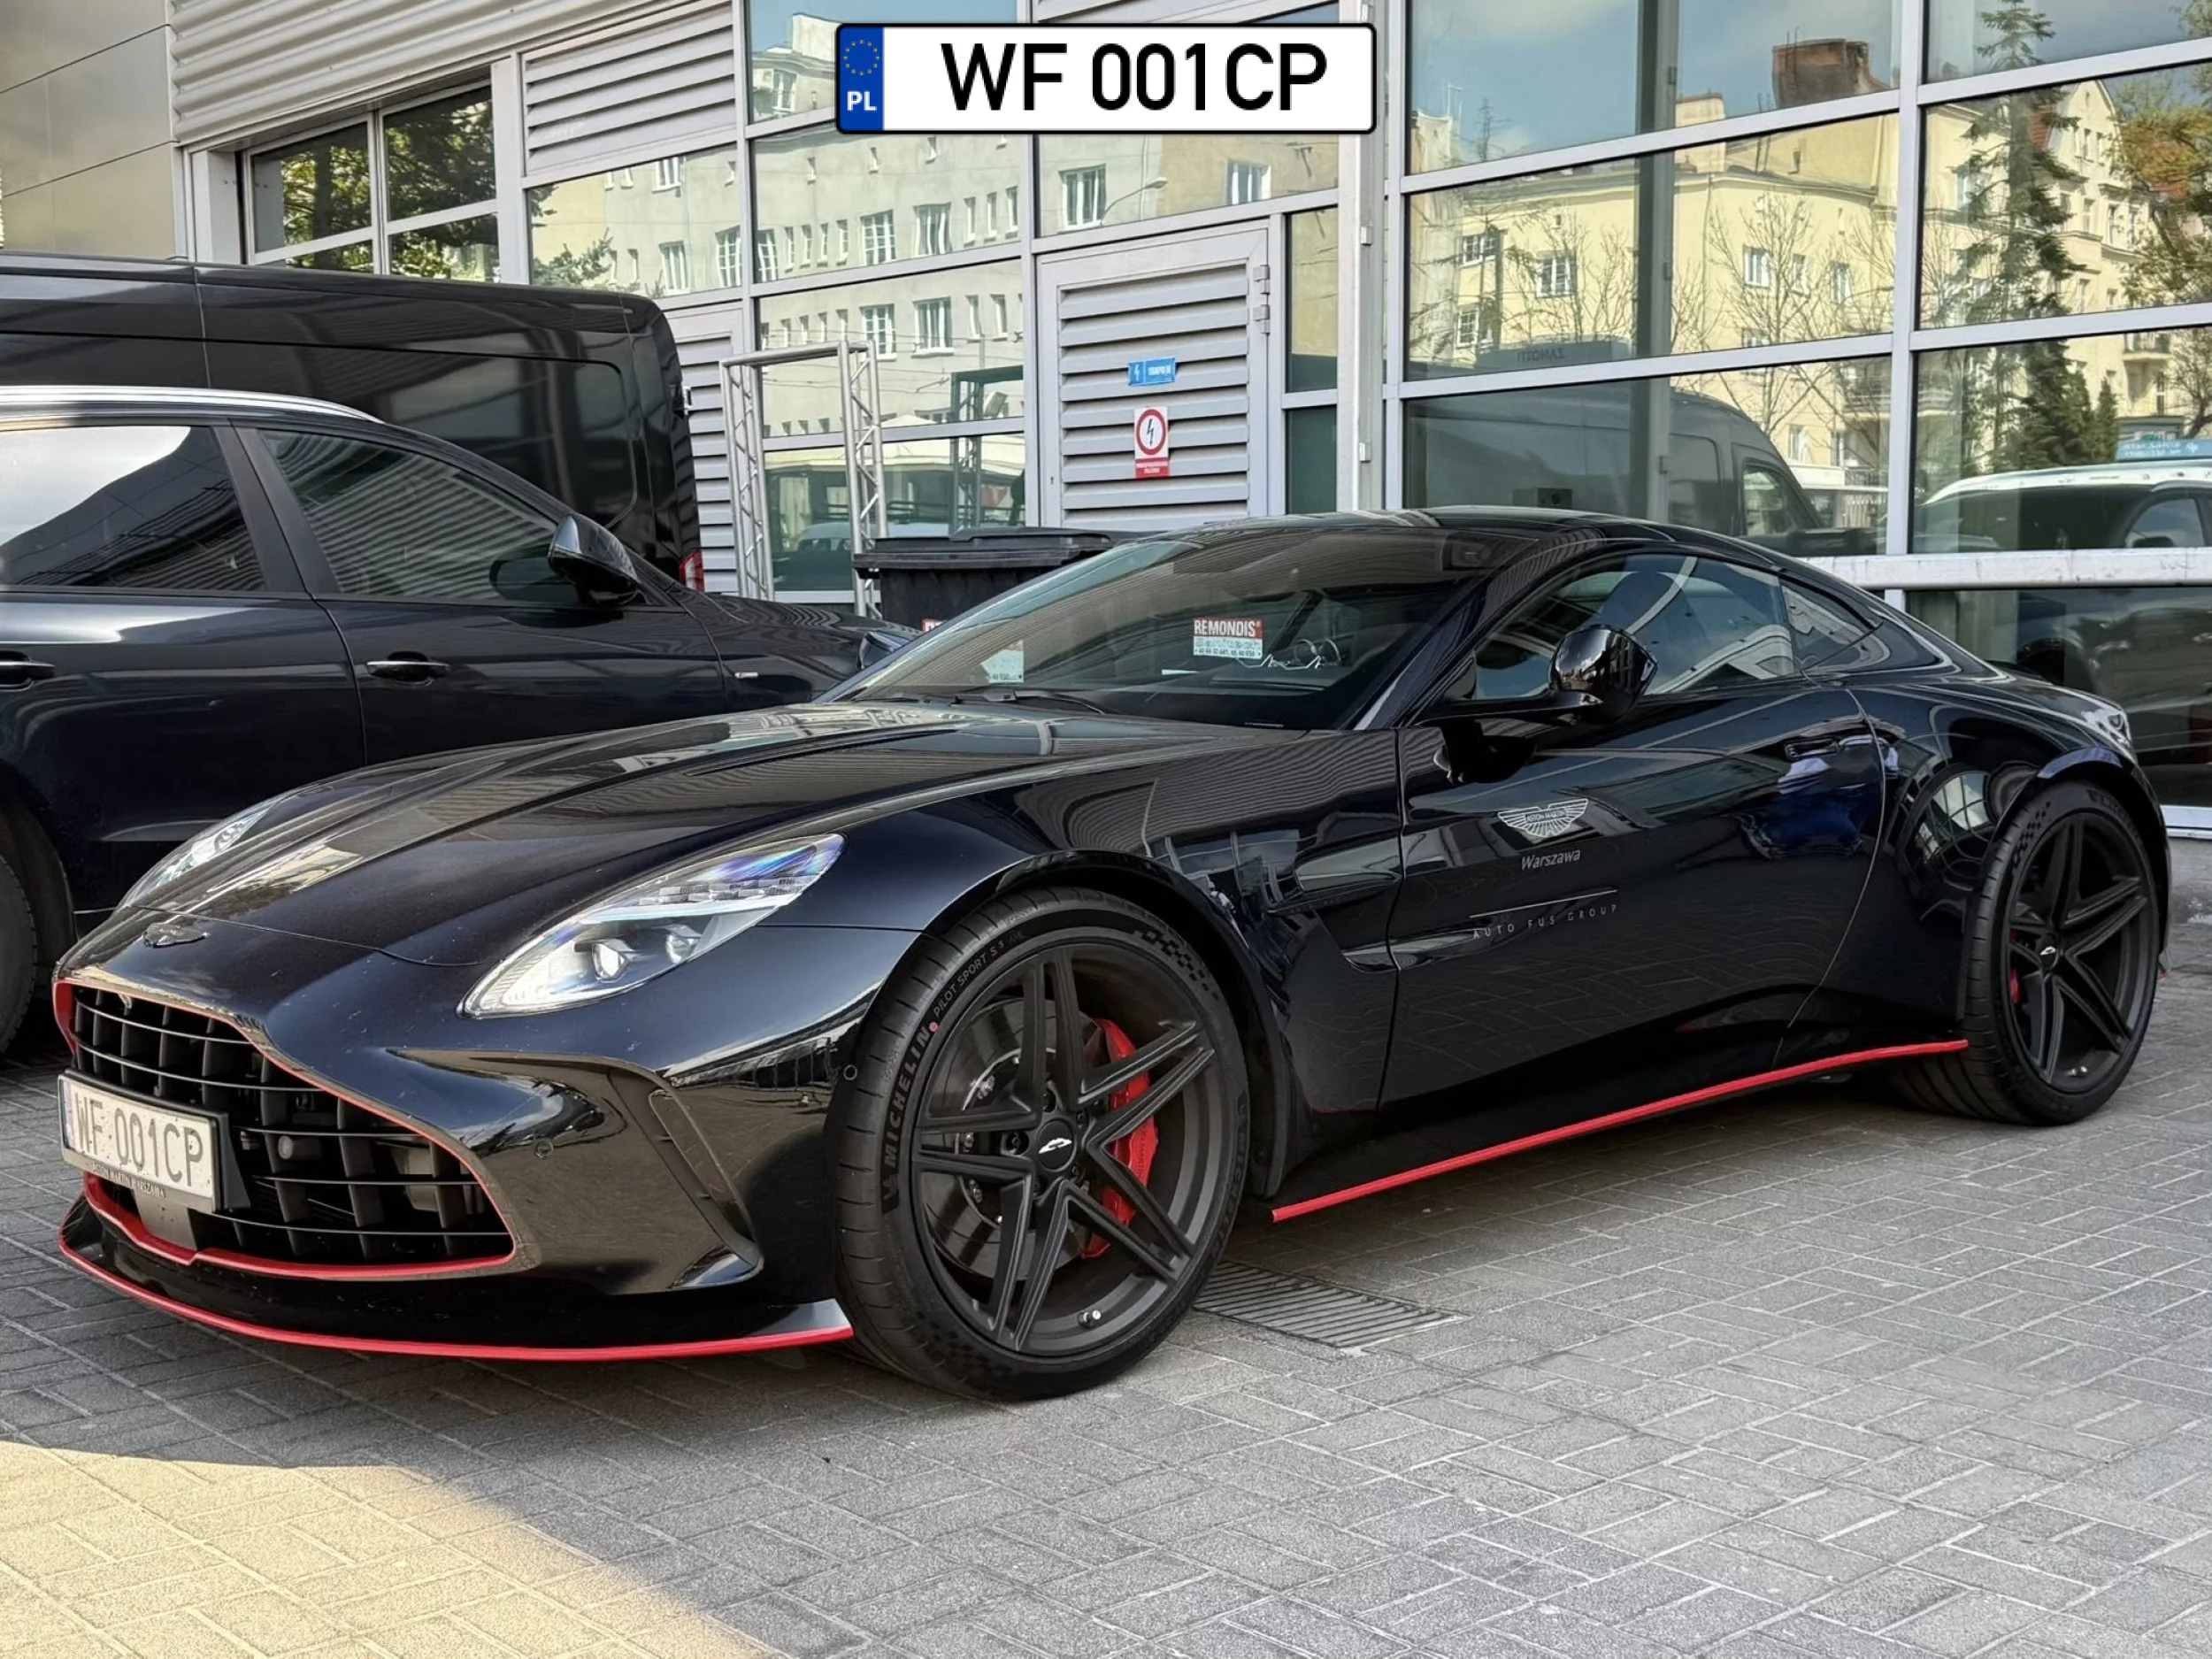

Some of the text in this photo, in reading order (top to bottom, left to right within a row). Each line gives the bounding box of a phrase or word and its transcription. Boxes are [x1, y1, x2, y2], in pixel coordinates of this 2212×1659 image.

[1194, 620, 1256, 637] REMONDIS
[1522, 849, 1580, 871] Warszawa
[1473, 904, 1617, 939] AUTO FUS GROUP
[885, 1026, 930, 1168] MICHELIN
[933, 984, 957, 1018] PILOT
[957, 953, 987, 987] SPORT
[75, 1093, 204, 1187] WF 001CP
